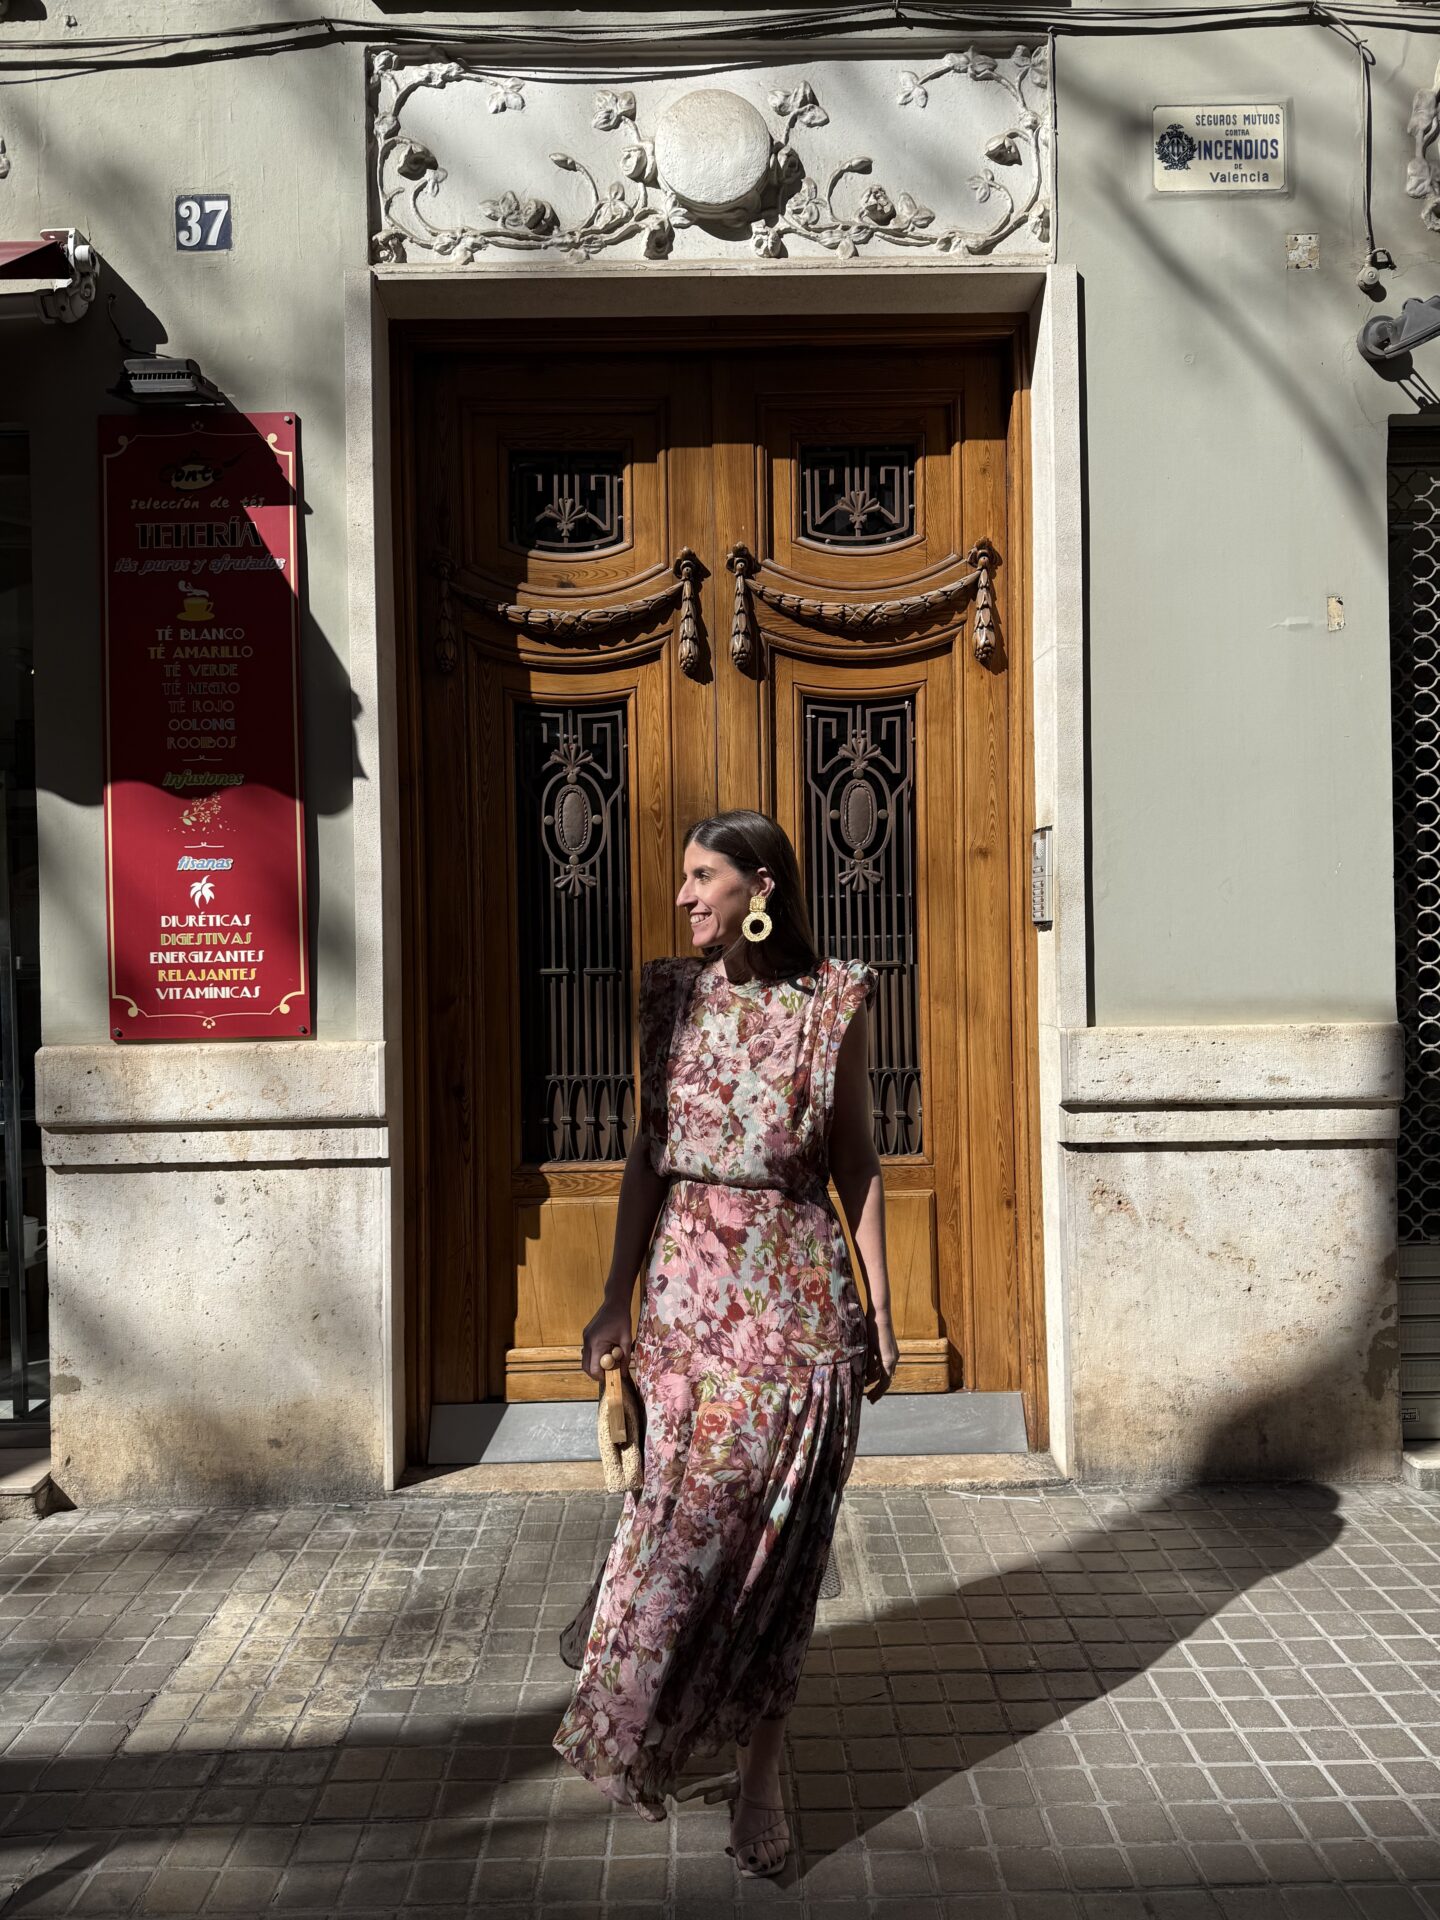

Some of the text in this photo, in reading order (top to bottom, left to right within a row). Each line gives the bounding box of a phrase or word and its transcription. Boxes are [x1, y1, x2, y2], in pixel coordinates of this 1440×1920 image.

[1195, 113, 1280, 126] SEGUROS MUTUOS
[1198, 138, 1279, 161] INCENDIOS
[1209, 171, 1270, 183] Valencia
[178, 200, 229, 247] 37
[129, 494, 266, 510] selección de tés
[135, 516, 264, 549] TETERÍA
[138, 558, 191, 576] puros
[193, 558, 207, 575] y
[155, 625, 246, 641] TÉ BLANCO
[147, 643, 254, 659] TÉ AMARILLO
[163, 661, 239, 677] TÉ VERDE
[161, 679, 241, 695] TÉ NEGRO
[168, 697, 235, 713] TÉ ROJO
[168, 718, 236, 731] OOLONG
[166, 736, 238, 750] ROOIBOS
[177, 855, 234, 871] tisanas
[161, 912, 251, 927] DIURÉTICAS
[160, 932, 252, 945] DIGESTIVAS
[150, 950, 264, 964] ENERGIZANTES
[158, 968, 257, 982] RELAJANTES
[155, 983, 261, 1000] VITAMÍNICAS
